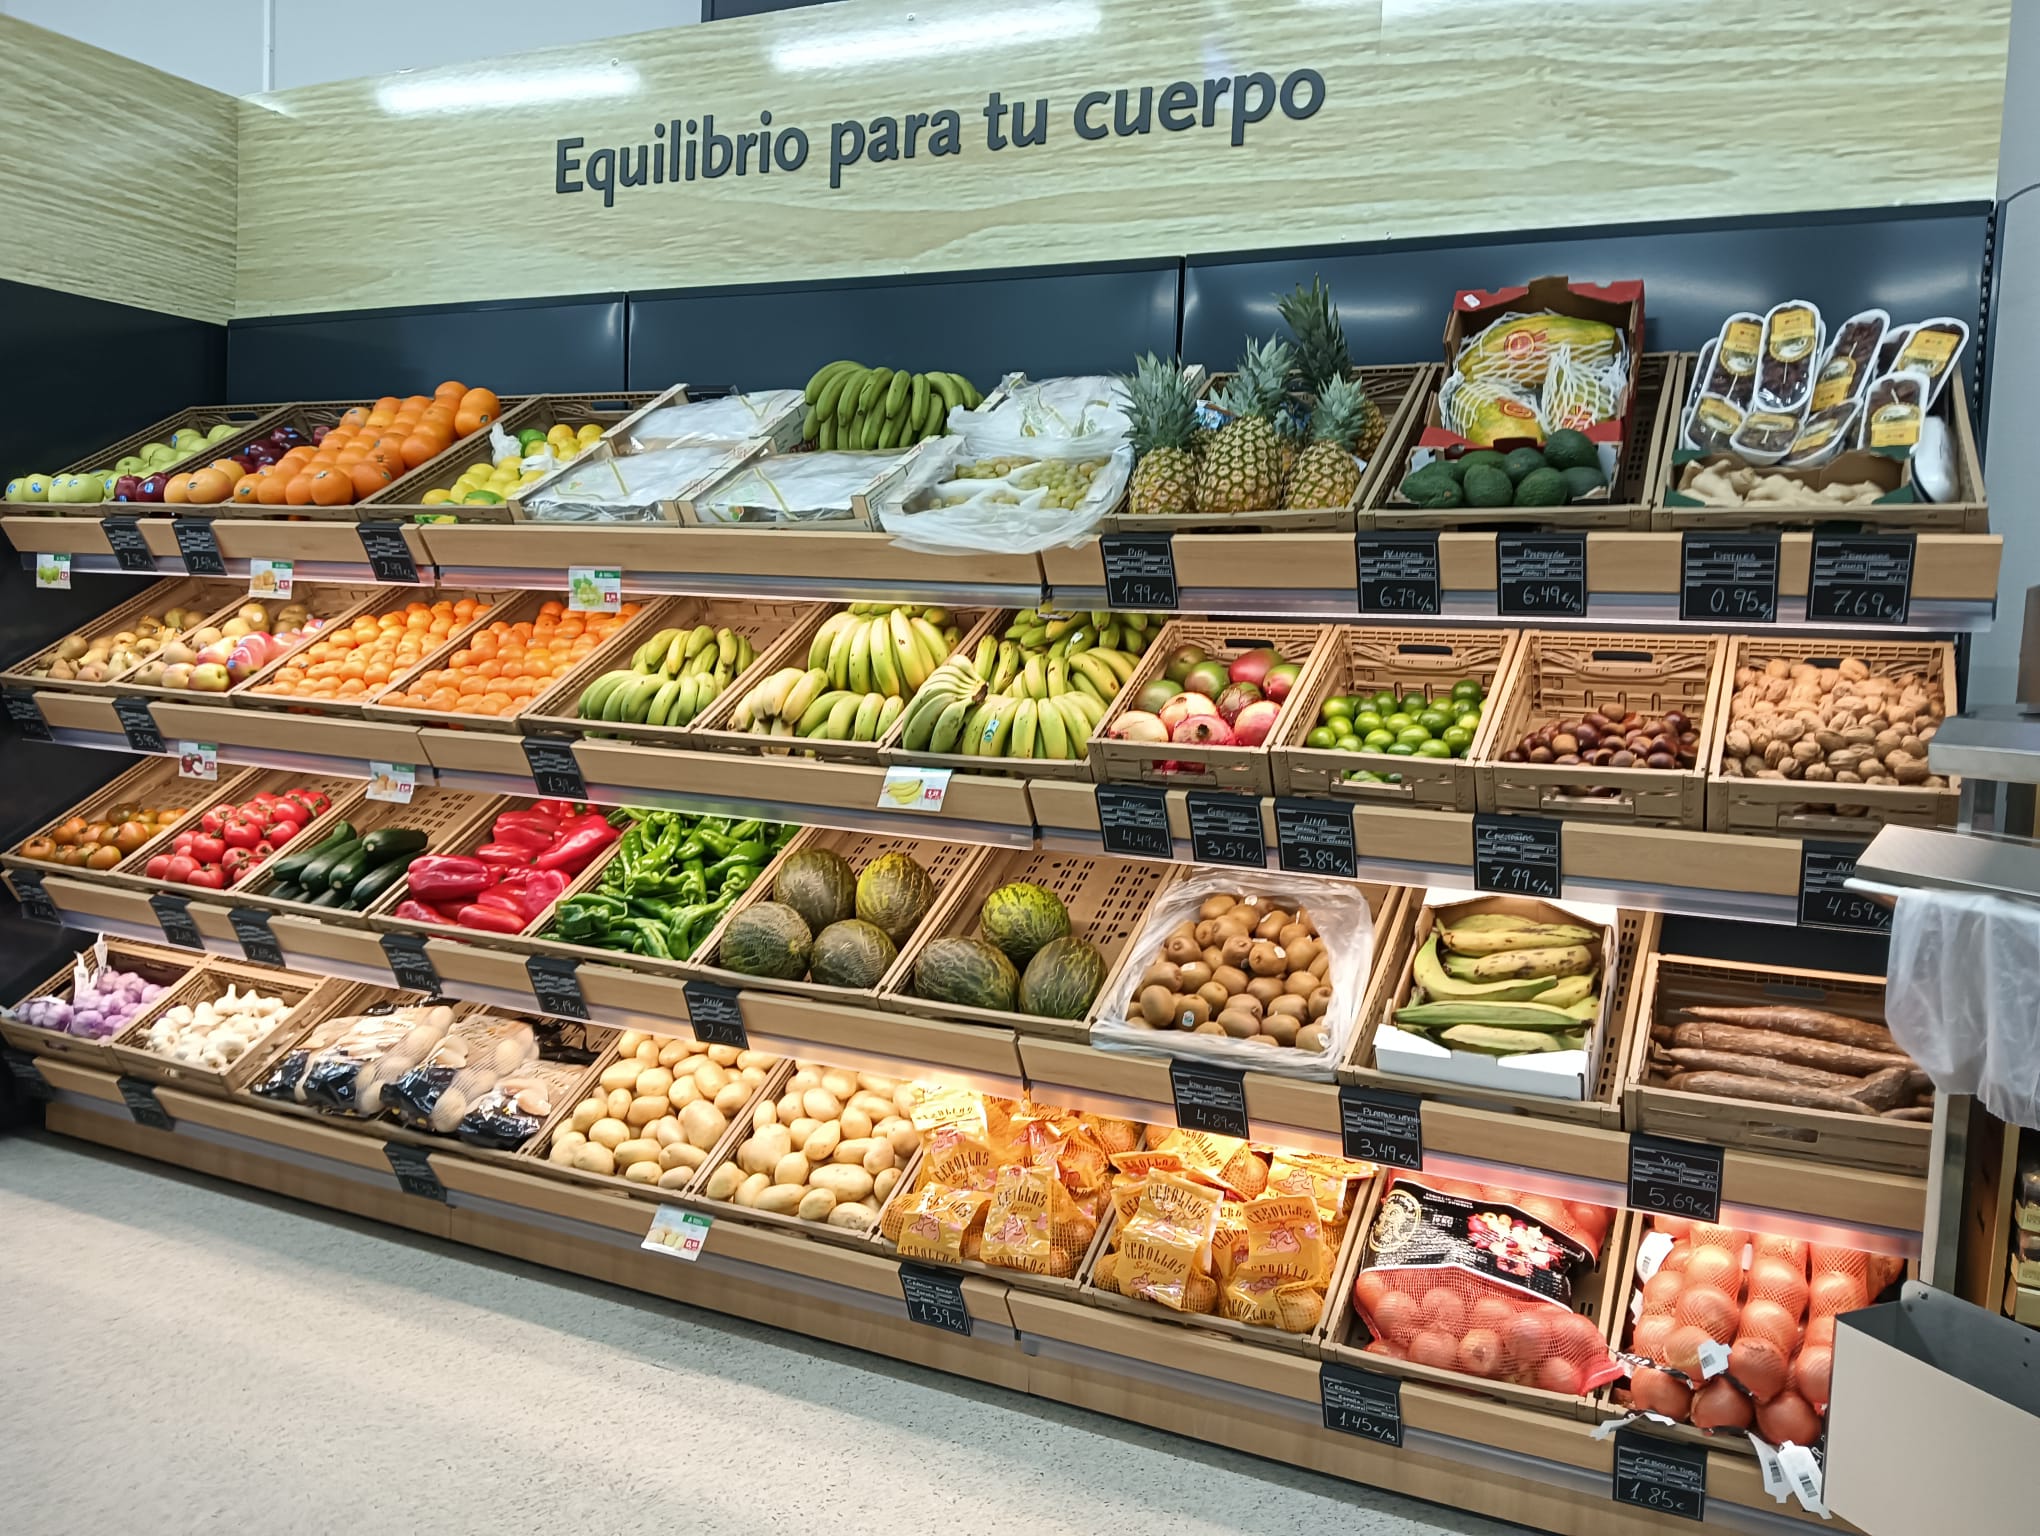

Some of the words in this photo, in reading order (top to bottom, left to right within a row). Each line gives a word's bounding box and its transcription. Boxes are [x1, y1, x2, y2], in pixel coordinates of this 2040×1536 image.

[555, 110, 809, 206] Equilibrio
[830, 109, 961, 188] para
[983, 91, 1049, 151] tu
[1074, 67, 1327, 146] cuerpo
